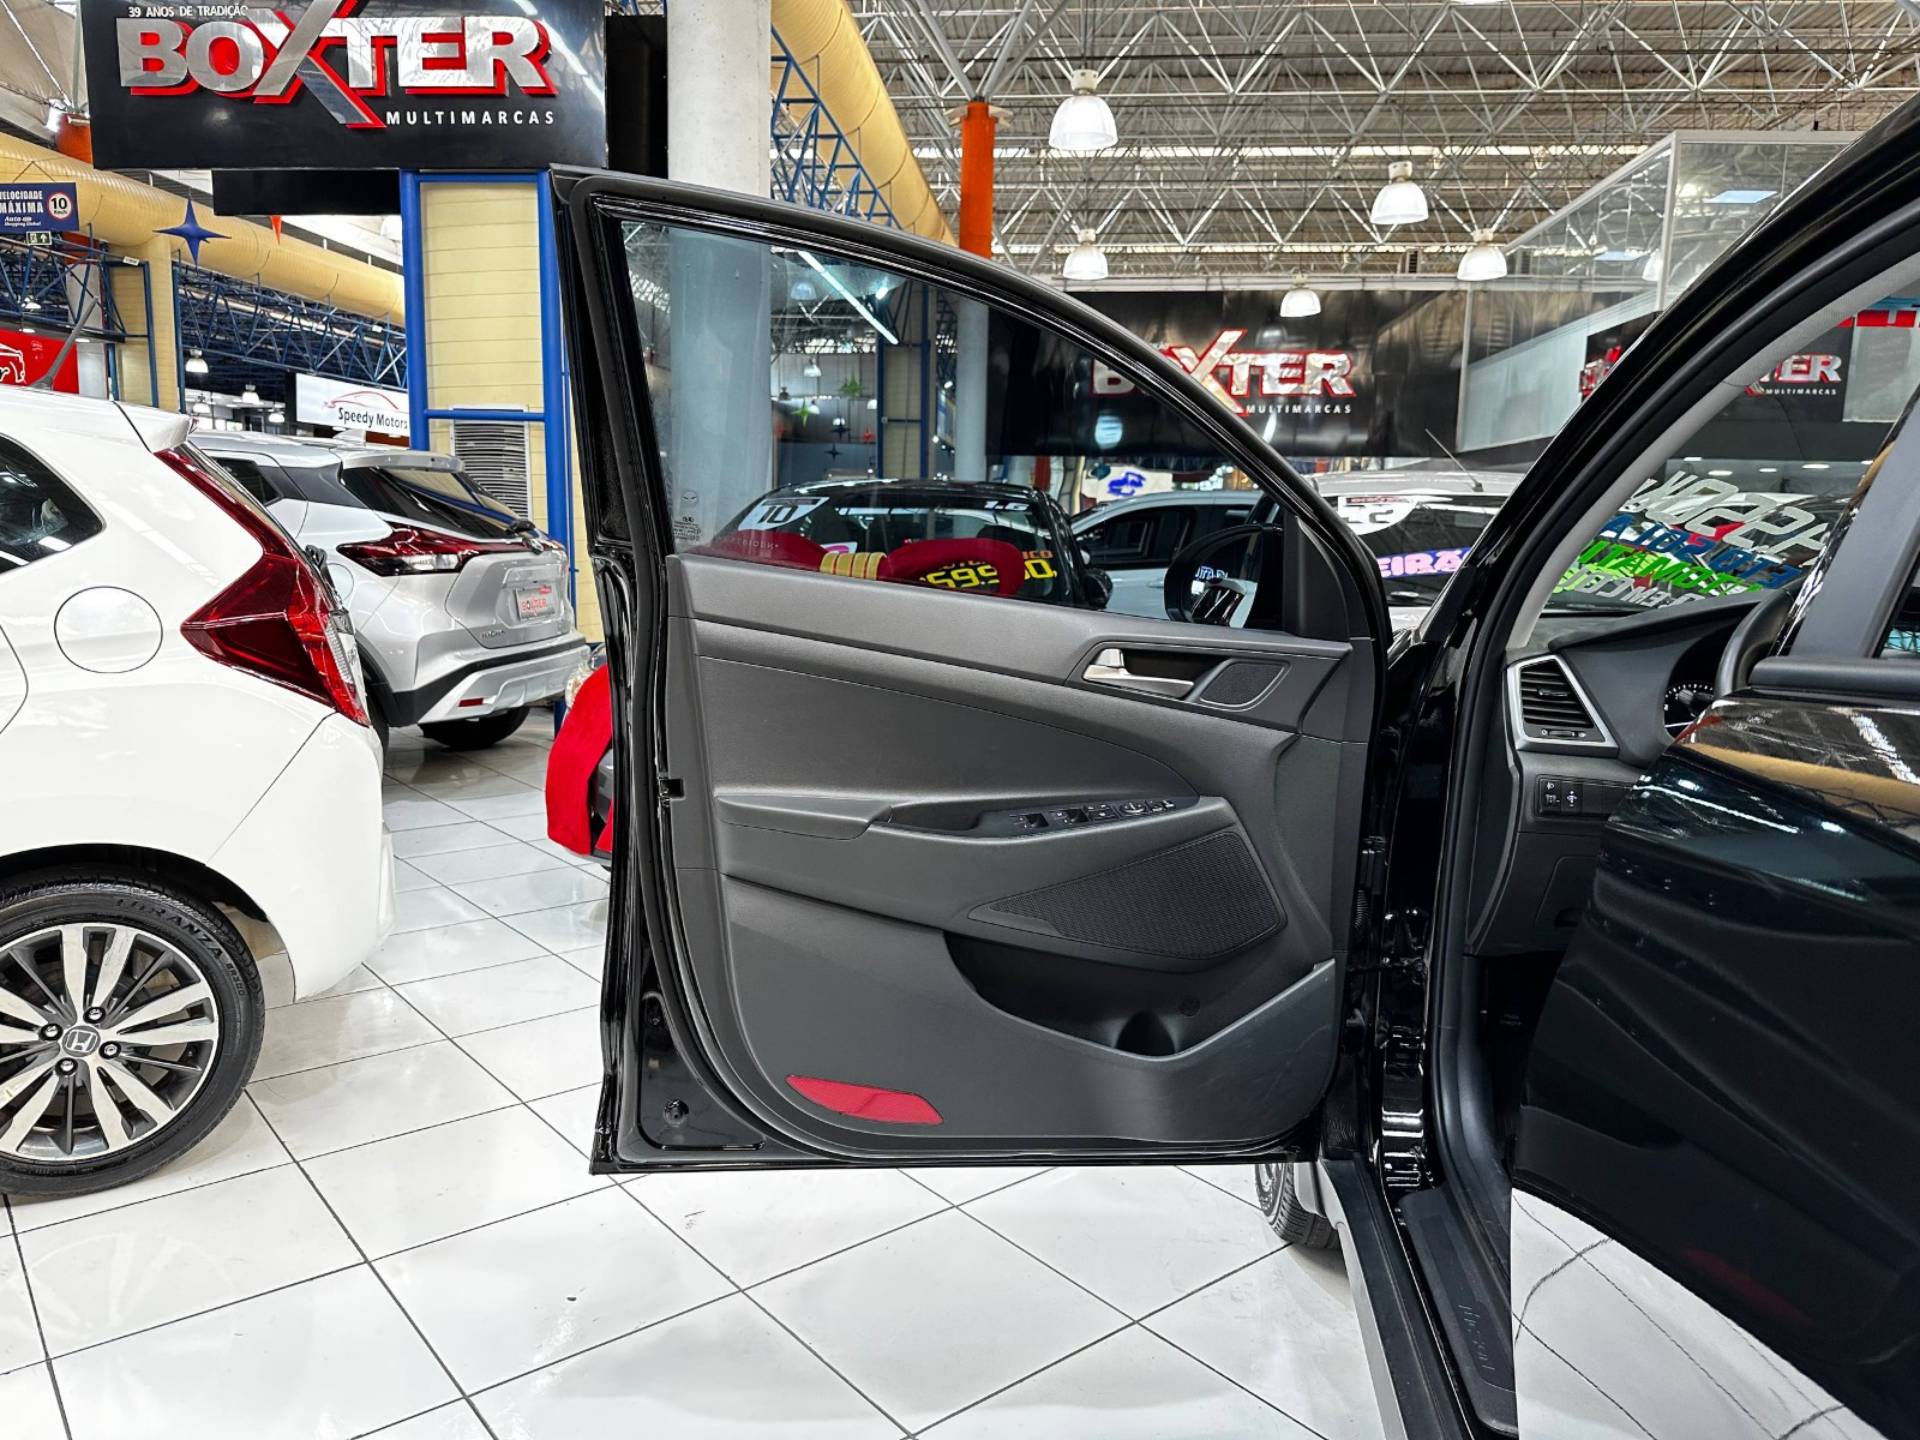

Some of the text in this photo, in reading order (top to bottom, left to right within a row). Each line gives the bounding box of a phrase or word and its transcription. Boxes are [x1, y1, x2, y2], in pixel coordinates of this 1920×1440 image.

[128, 4, 250, 18] 39 ANOS DE TRADIÇÃO
[115, 0, 558, 129] BOXTER
[385, 110, 555, 125] MULTIMARCAS
[0, 200, 44, 214] MÁXIMA
[51, 197, 68, 209] 10
[1091, 329, 1356, 416] BXTER
[1246, 404, 1352, 414] MULTIMARCAS
[338, 407, 408, 430] Speedy Motors
[757, 505, 798, 524] 10
[1376, 548, 1472, 578] EIRÃ
